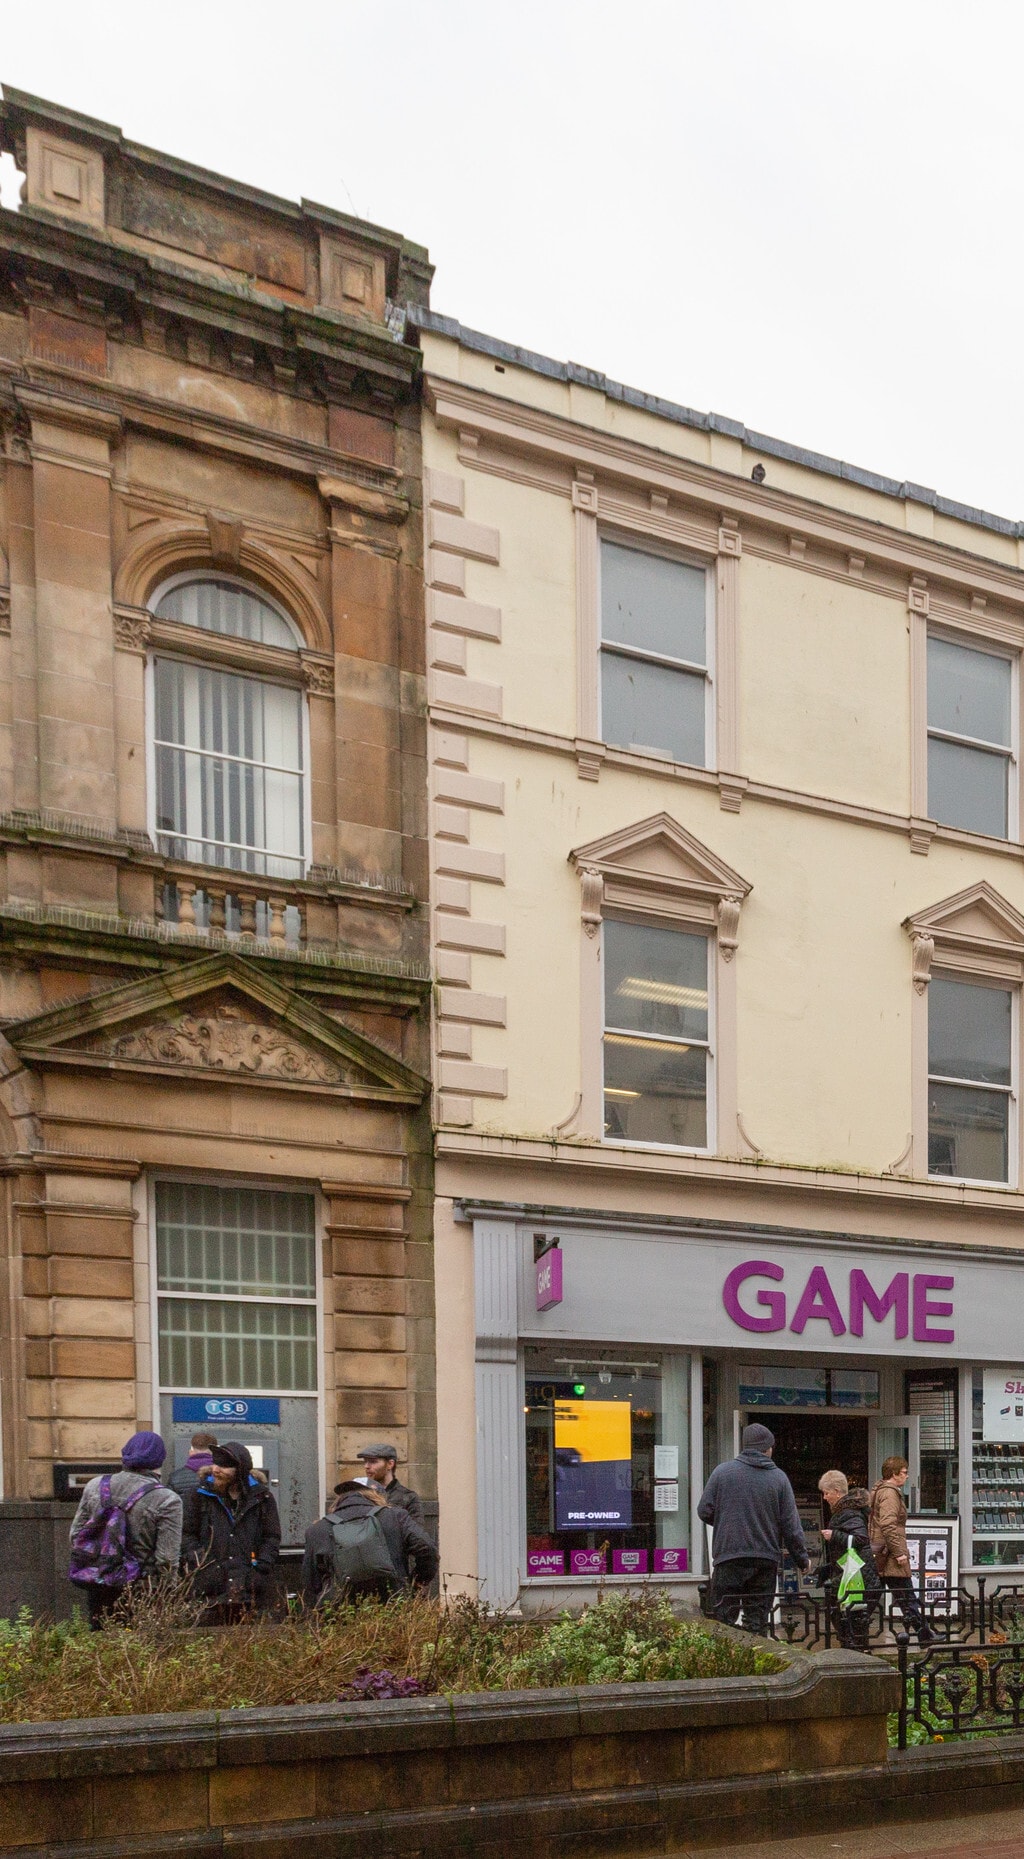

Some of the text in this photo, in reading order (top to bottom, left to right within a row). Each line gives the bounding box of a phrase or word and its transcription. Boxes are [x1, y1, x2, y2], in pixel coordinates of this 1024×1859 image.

[722, 1260, 955, 1343] GAME
[208, 1402, 246, 1413] TSB
[568, 1511, 621, 1519] PRE-OWNED
[529, 1555, 563, 1565] GAME
